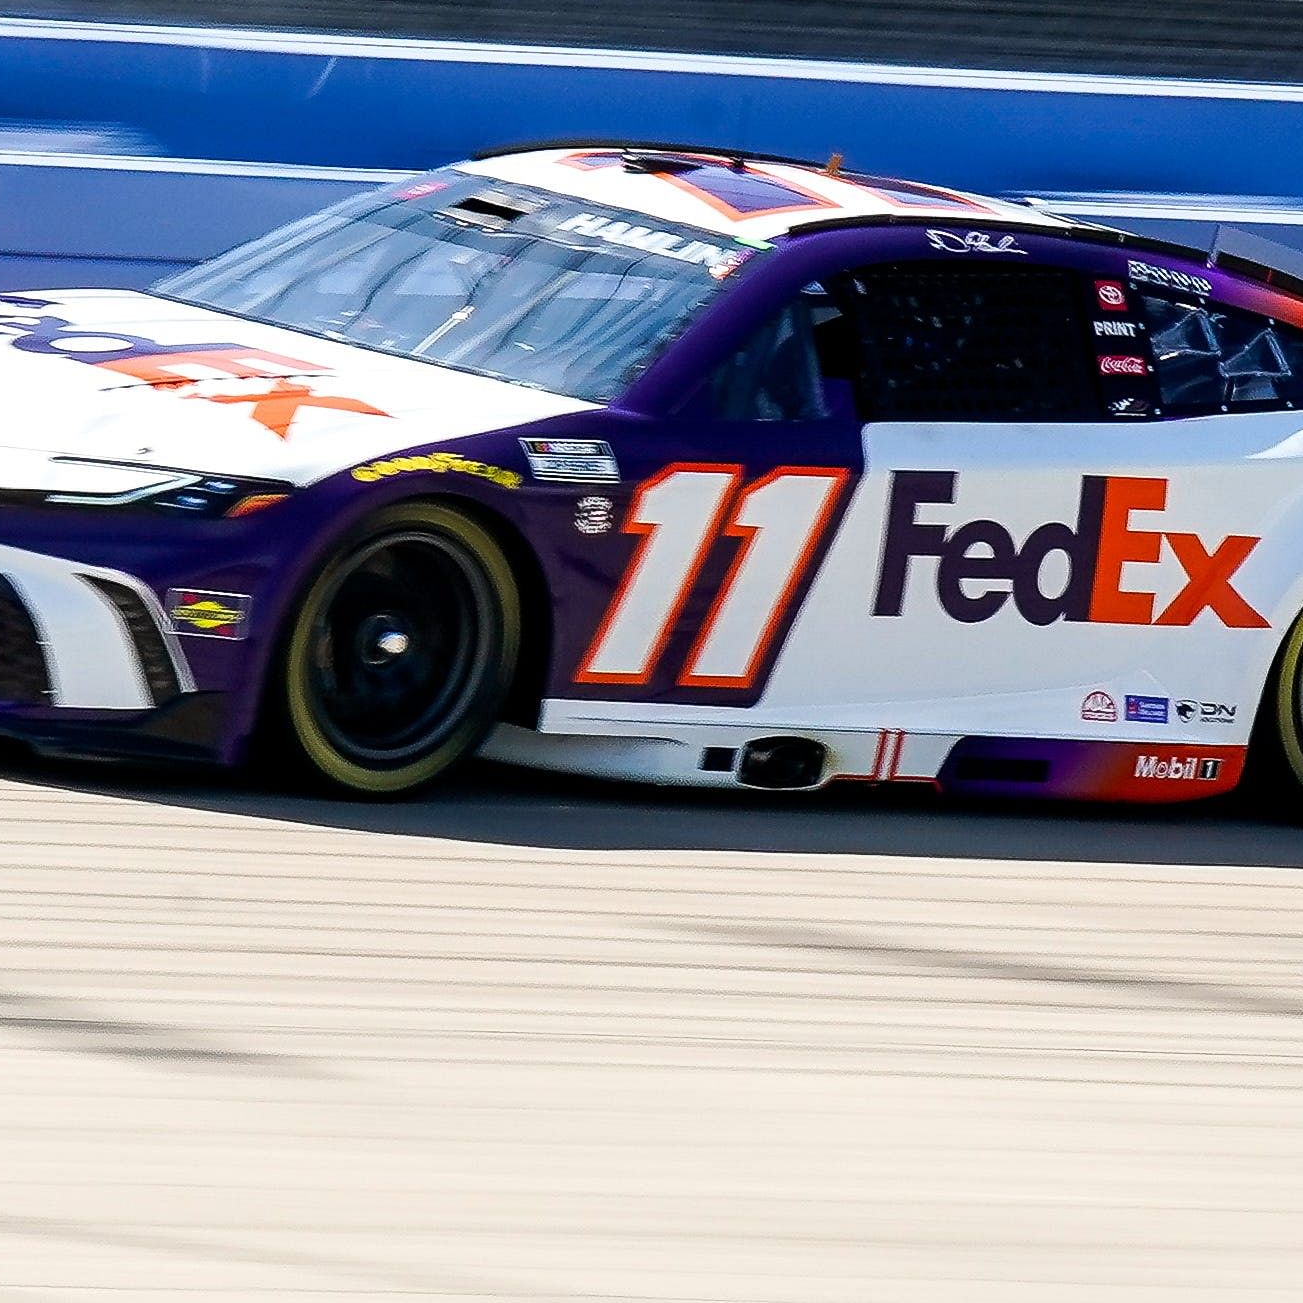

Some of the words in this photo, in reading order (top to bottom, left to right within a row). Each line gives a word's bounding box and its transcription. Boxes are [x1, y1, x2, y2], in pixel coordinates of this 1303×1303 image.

[1093, 320, 1137, 338] PRINT
[573, 462, 852, 688] 11
[870, 469, 1273, 629] FedEx
[1133, 755, 1198, 780] Mobil
